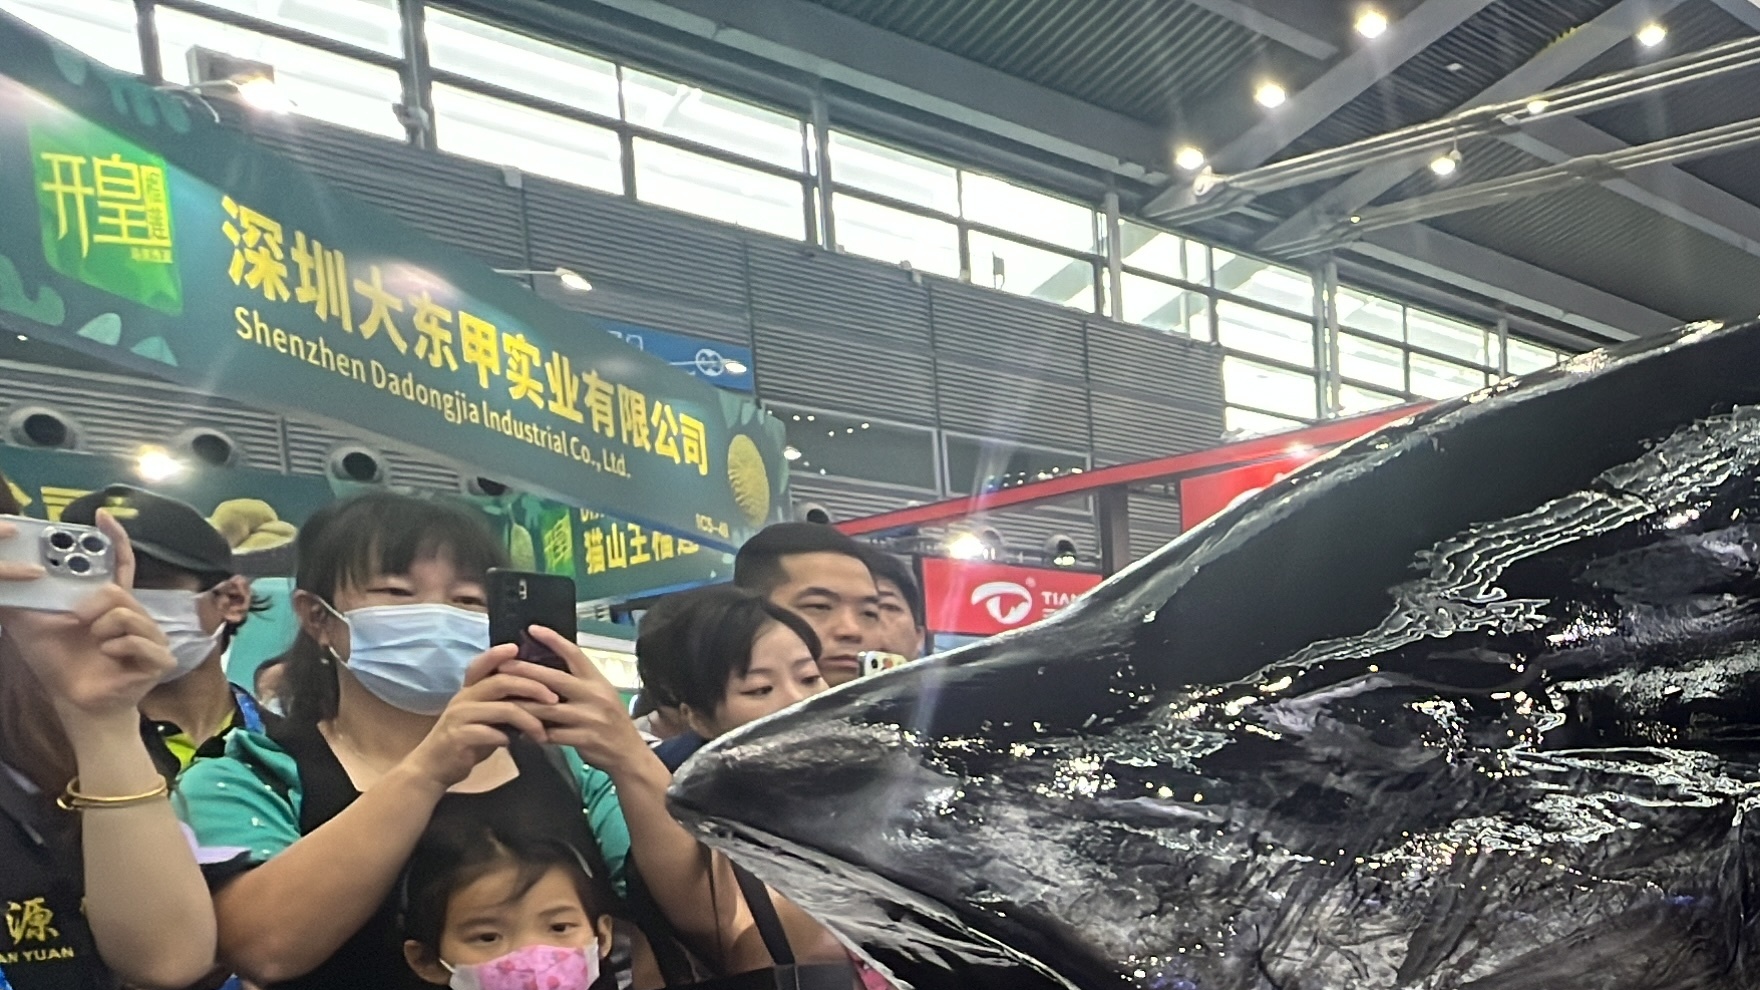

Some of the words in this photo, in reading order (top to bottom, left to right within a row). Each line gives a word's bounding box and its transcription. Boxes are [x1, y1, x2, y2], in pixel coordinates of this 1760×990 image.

[40, 151, 172, 259] 开皇
[222, 195, 708, 475] 深圳大东甲实业有限公司
[234, 306, 366, 383] Shenzhen
[370, 359, 479, 425] Dadongjia
[482, 401, 569, 457] Industrial
[570, 437, 601, 472] Co.,
[602, 449, 631, 478] Ltd.
[5, 897, 60, 945] 源
[22, 947, 75, 962] YUAN
